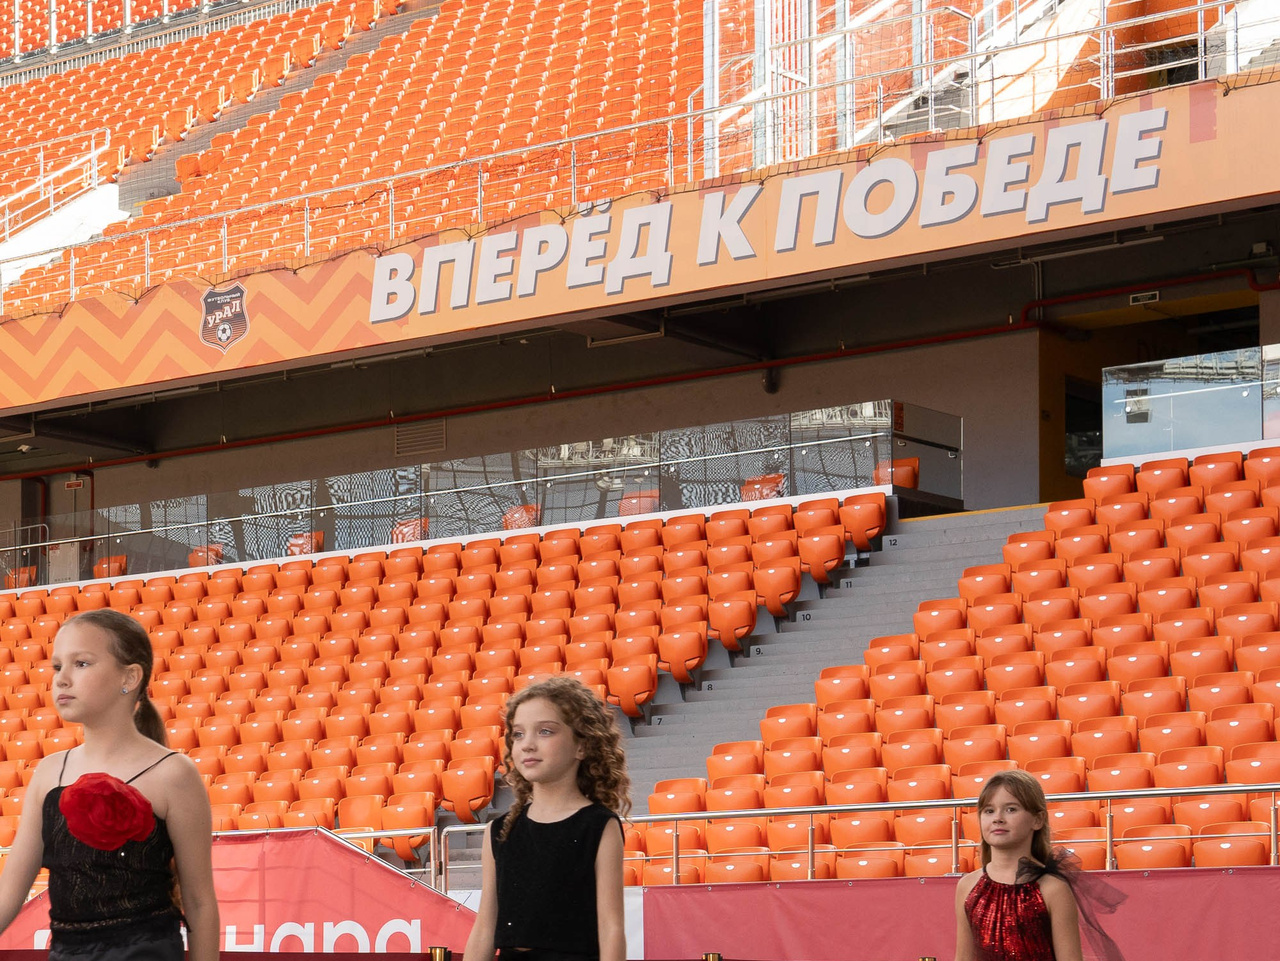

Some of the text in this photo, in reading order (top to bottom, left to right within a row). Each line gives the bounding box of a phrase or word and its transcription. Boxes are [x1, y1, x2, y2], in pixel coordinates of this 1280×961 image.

[370, 107, 1169, 323] ВПЕРЁД К ПОБЕДЕ
[207, 301, 241, 328] УРАЛ
[889, 538, 898, 546] 12
[802, 613, 811, 621] 10
[657, 717, 662, 725] 7
